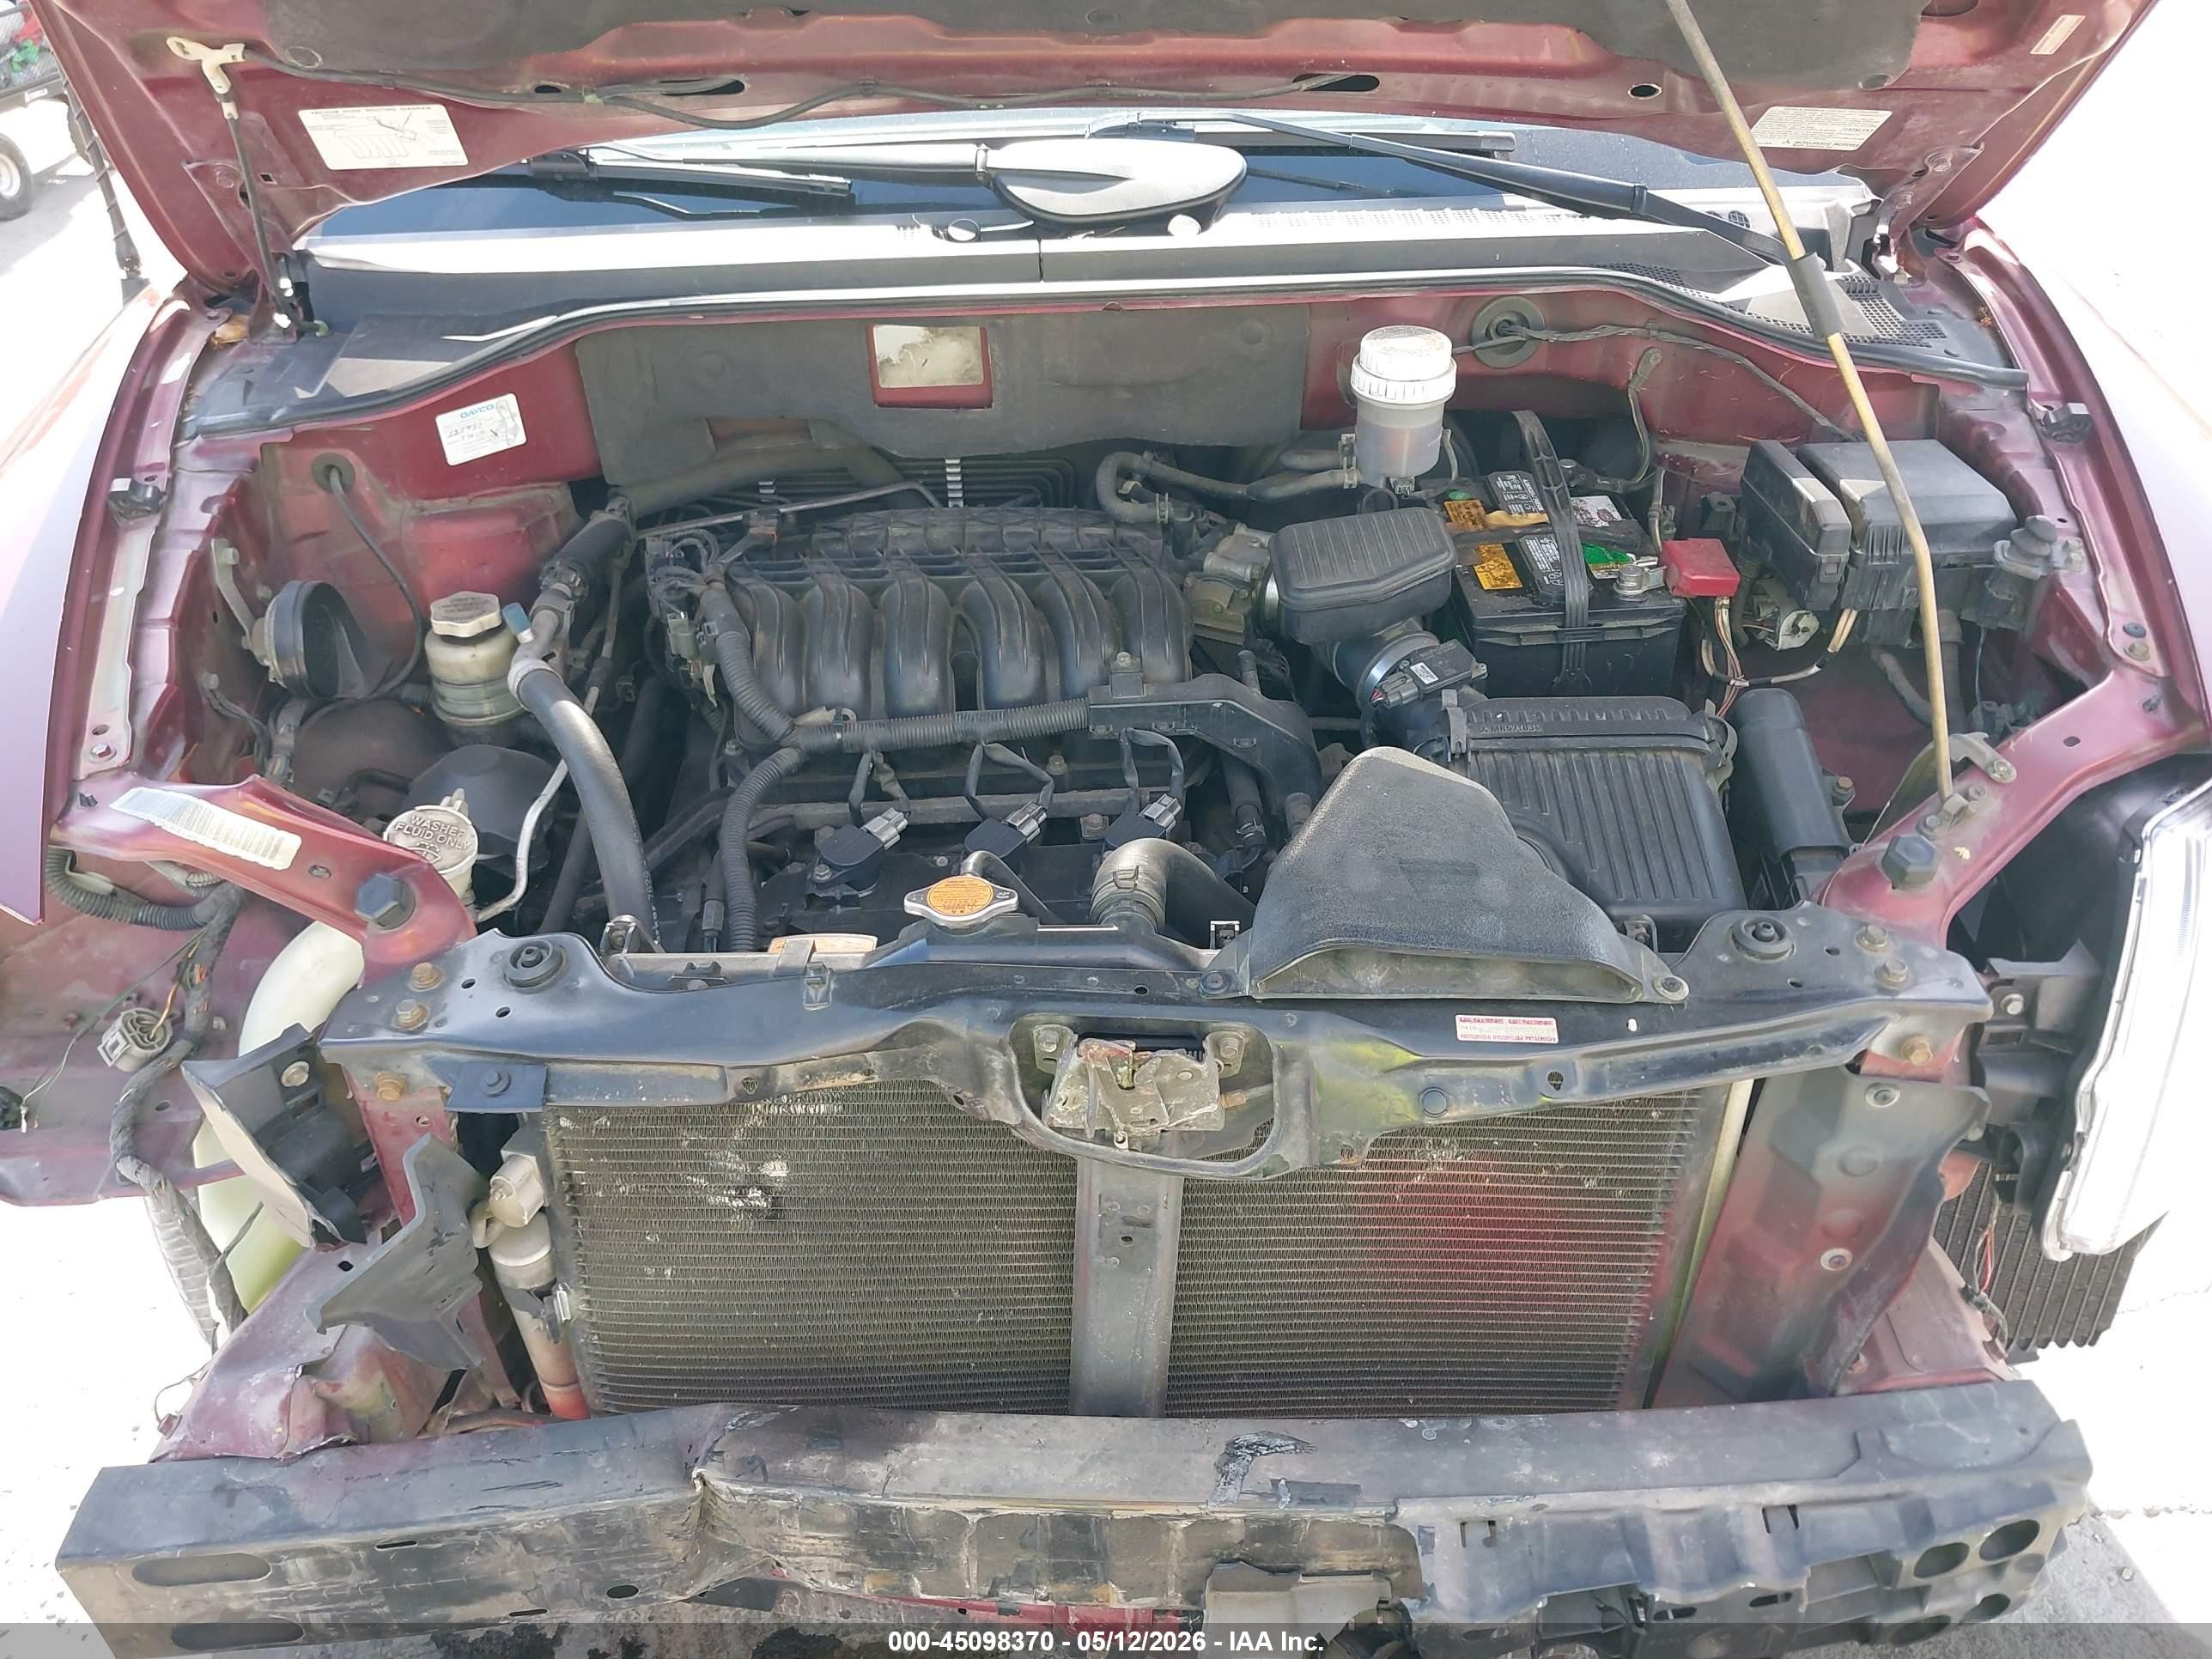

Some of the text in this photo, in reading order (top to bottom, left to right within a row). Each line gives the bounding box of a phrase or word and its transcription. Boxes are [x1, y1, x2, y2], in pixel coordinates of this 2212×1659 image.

[460, 404, 495, 419] DAYCO
[395, 822, 471, 850] FLUID ONLY
[411, 815, 467, 839] WASHER
